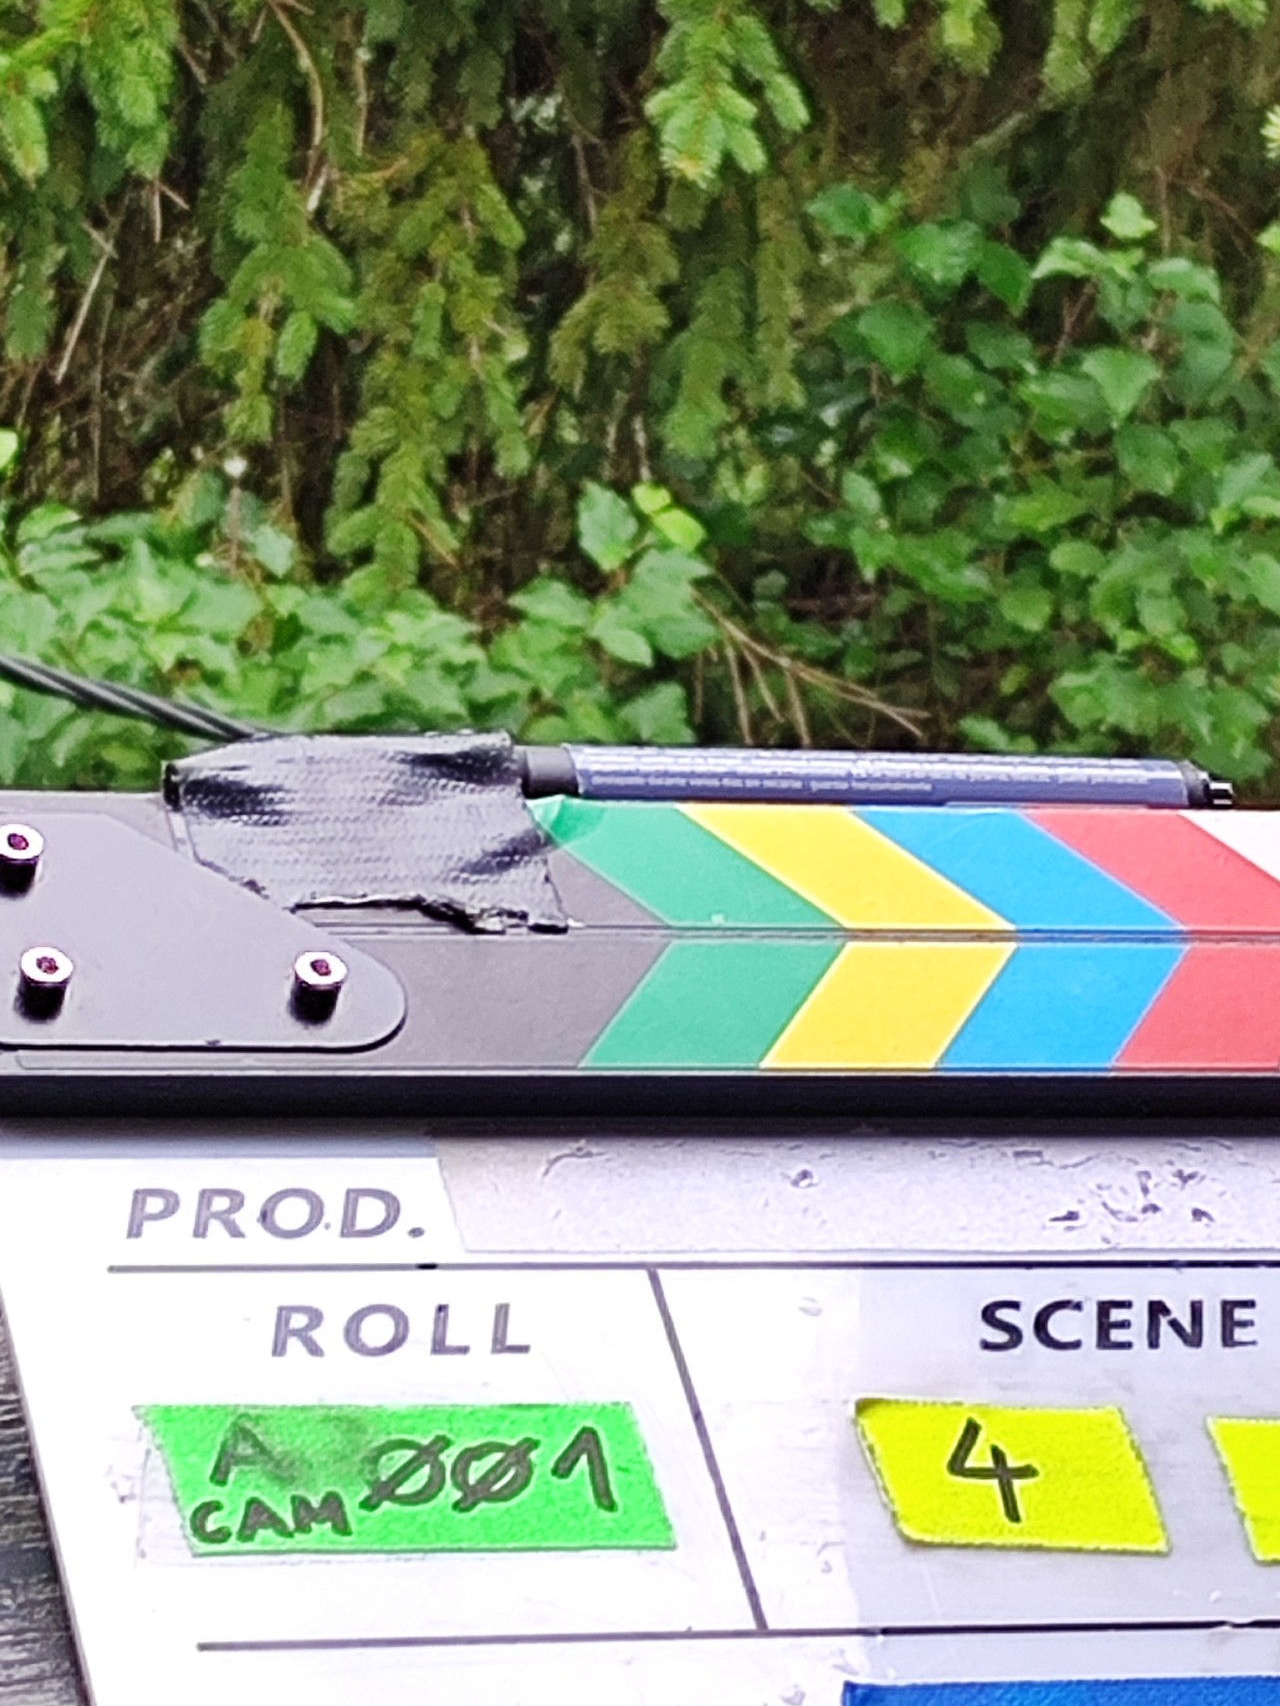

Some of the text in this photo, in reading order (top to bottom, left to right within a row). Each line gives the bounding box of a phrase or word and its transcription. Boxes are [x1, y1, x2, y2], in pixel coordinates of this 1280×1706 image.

[127, 1185, 426, 1240] PROD.
[271, 1303, 532, 1357] ROLL
[978, 1298, 1259, 1353] SCENE
[948, 1419, 1038, 1522] 4
[190, 1491, 353, 1544] CAM
